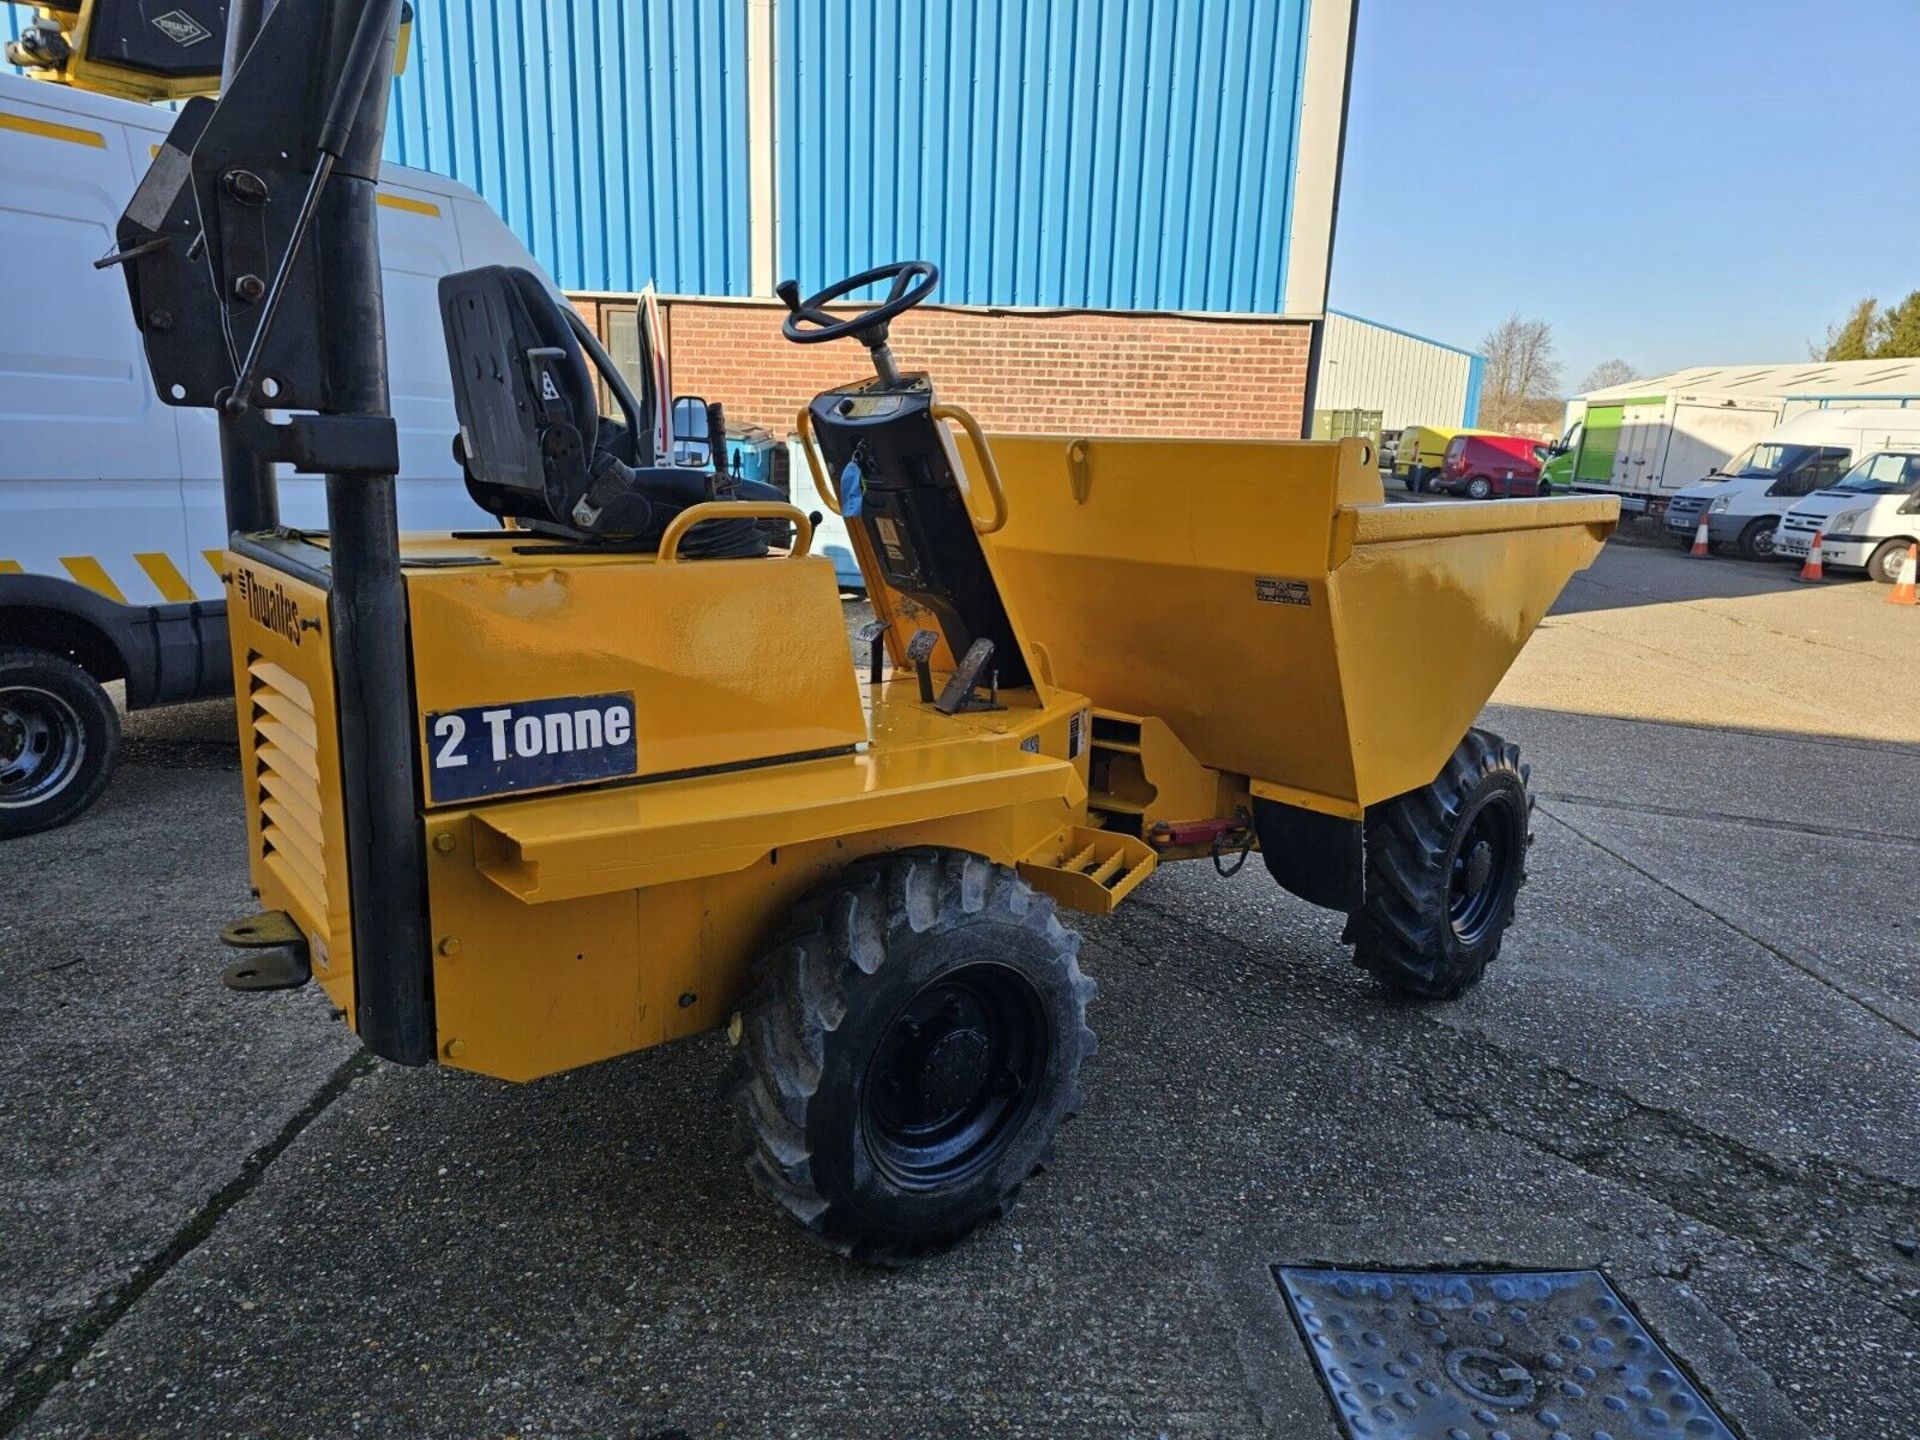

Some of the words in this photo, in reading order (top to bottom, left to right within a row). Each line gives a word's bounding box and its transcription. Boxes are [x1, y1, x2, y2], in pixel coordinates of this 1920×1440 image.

[245, 569, 300, 646] Thwaites
[434, 715, 468, 768] 2
[482, 706, 631, 762] Tonne
